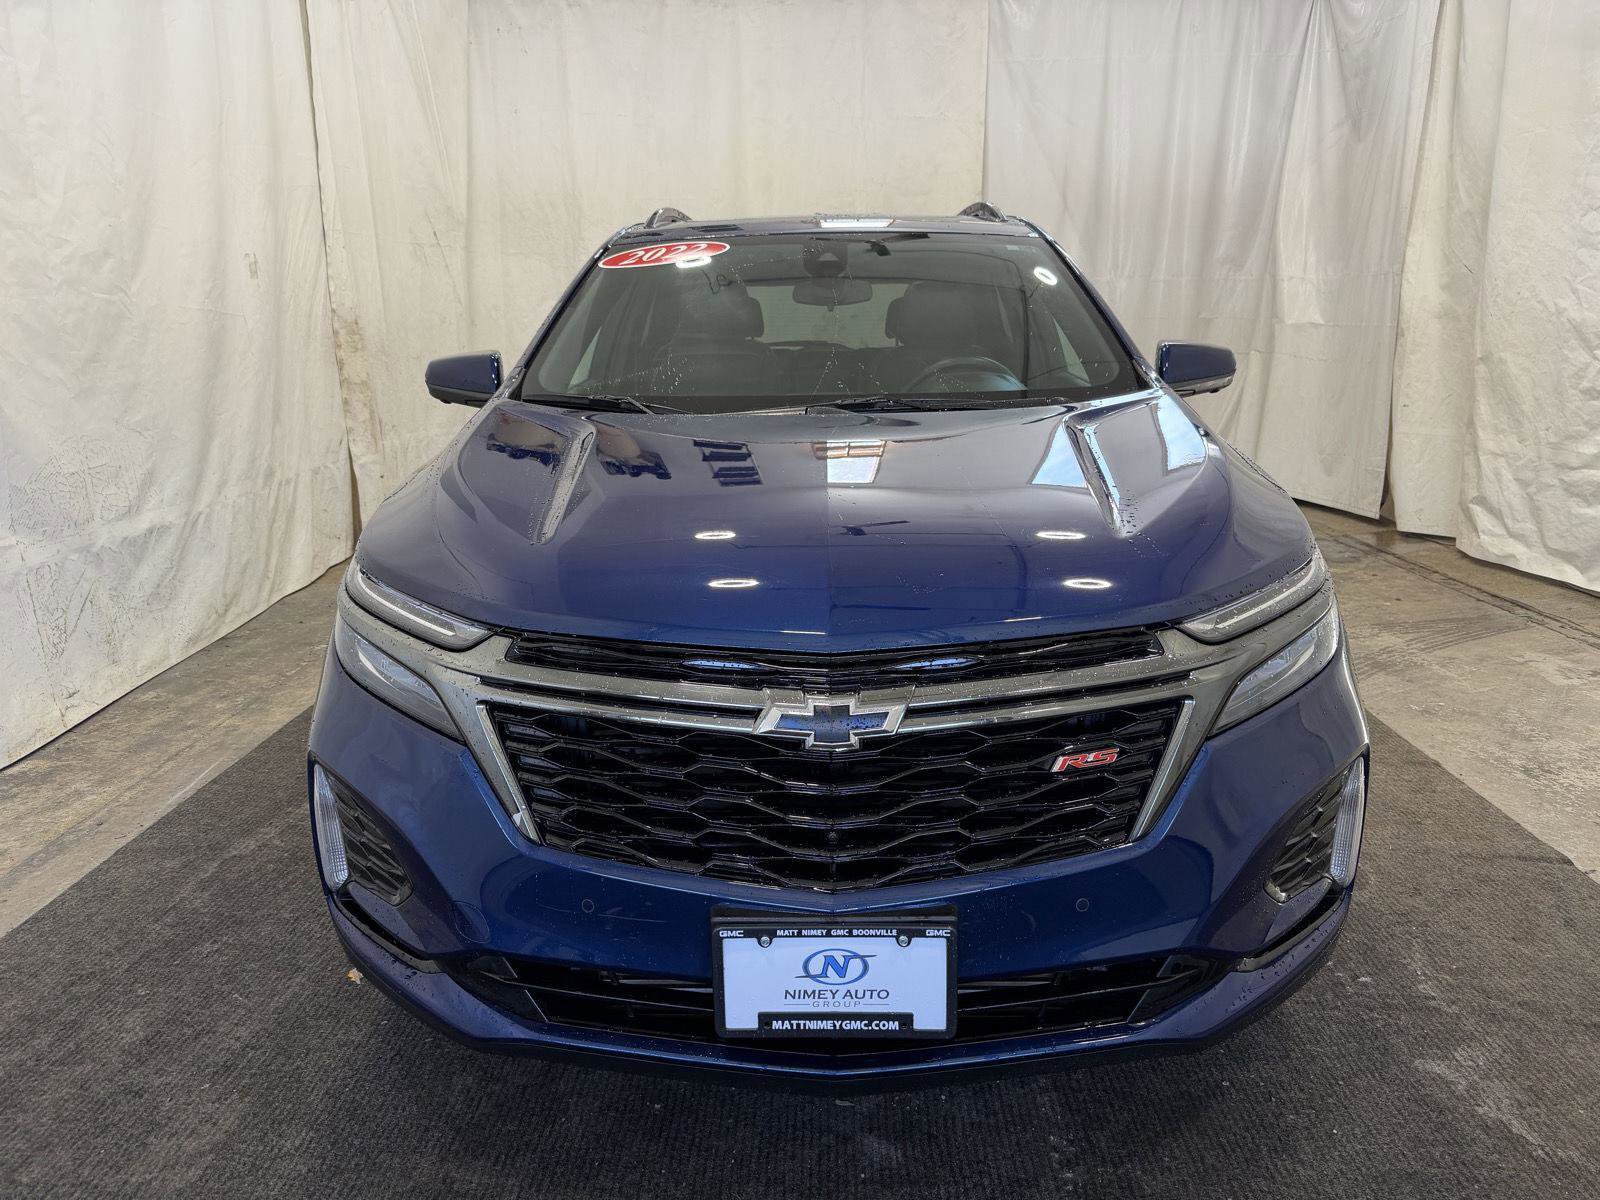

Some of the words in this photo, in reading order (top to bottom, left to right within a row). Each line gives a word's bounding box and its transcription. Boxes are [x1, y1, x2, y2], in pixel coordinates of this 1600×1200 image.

[1050, 747, 1120, 773] RS
[784, 989, 840, 1000] NIMEY
[842, 989, 890, 1000] AUTO
[772, 1020, 899, 1030] MATTNIMEYGMC.COM
